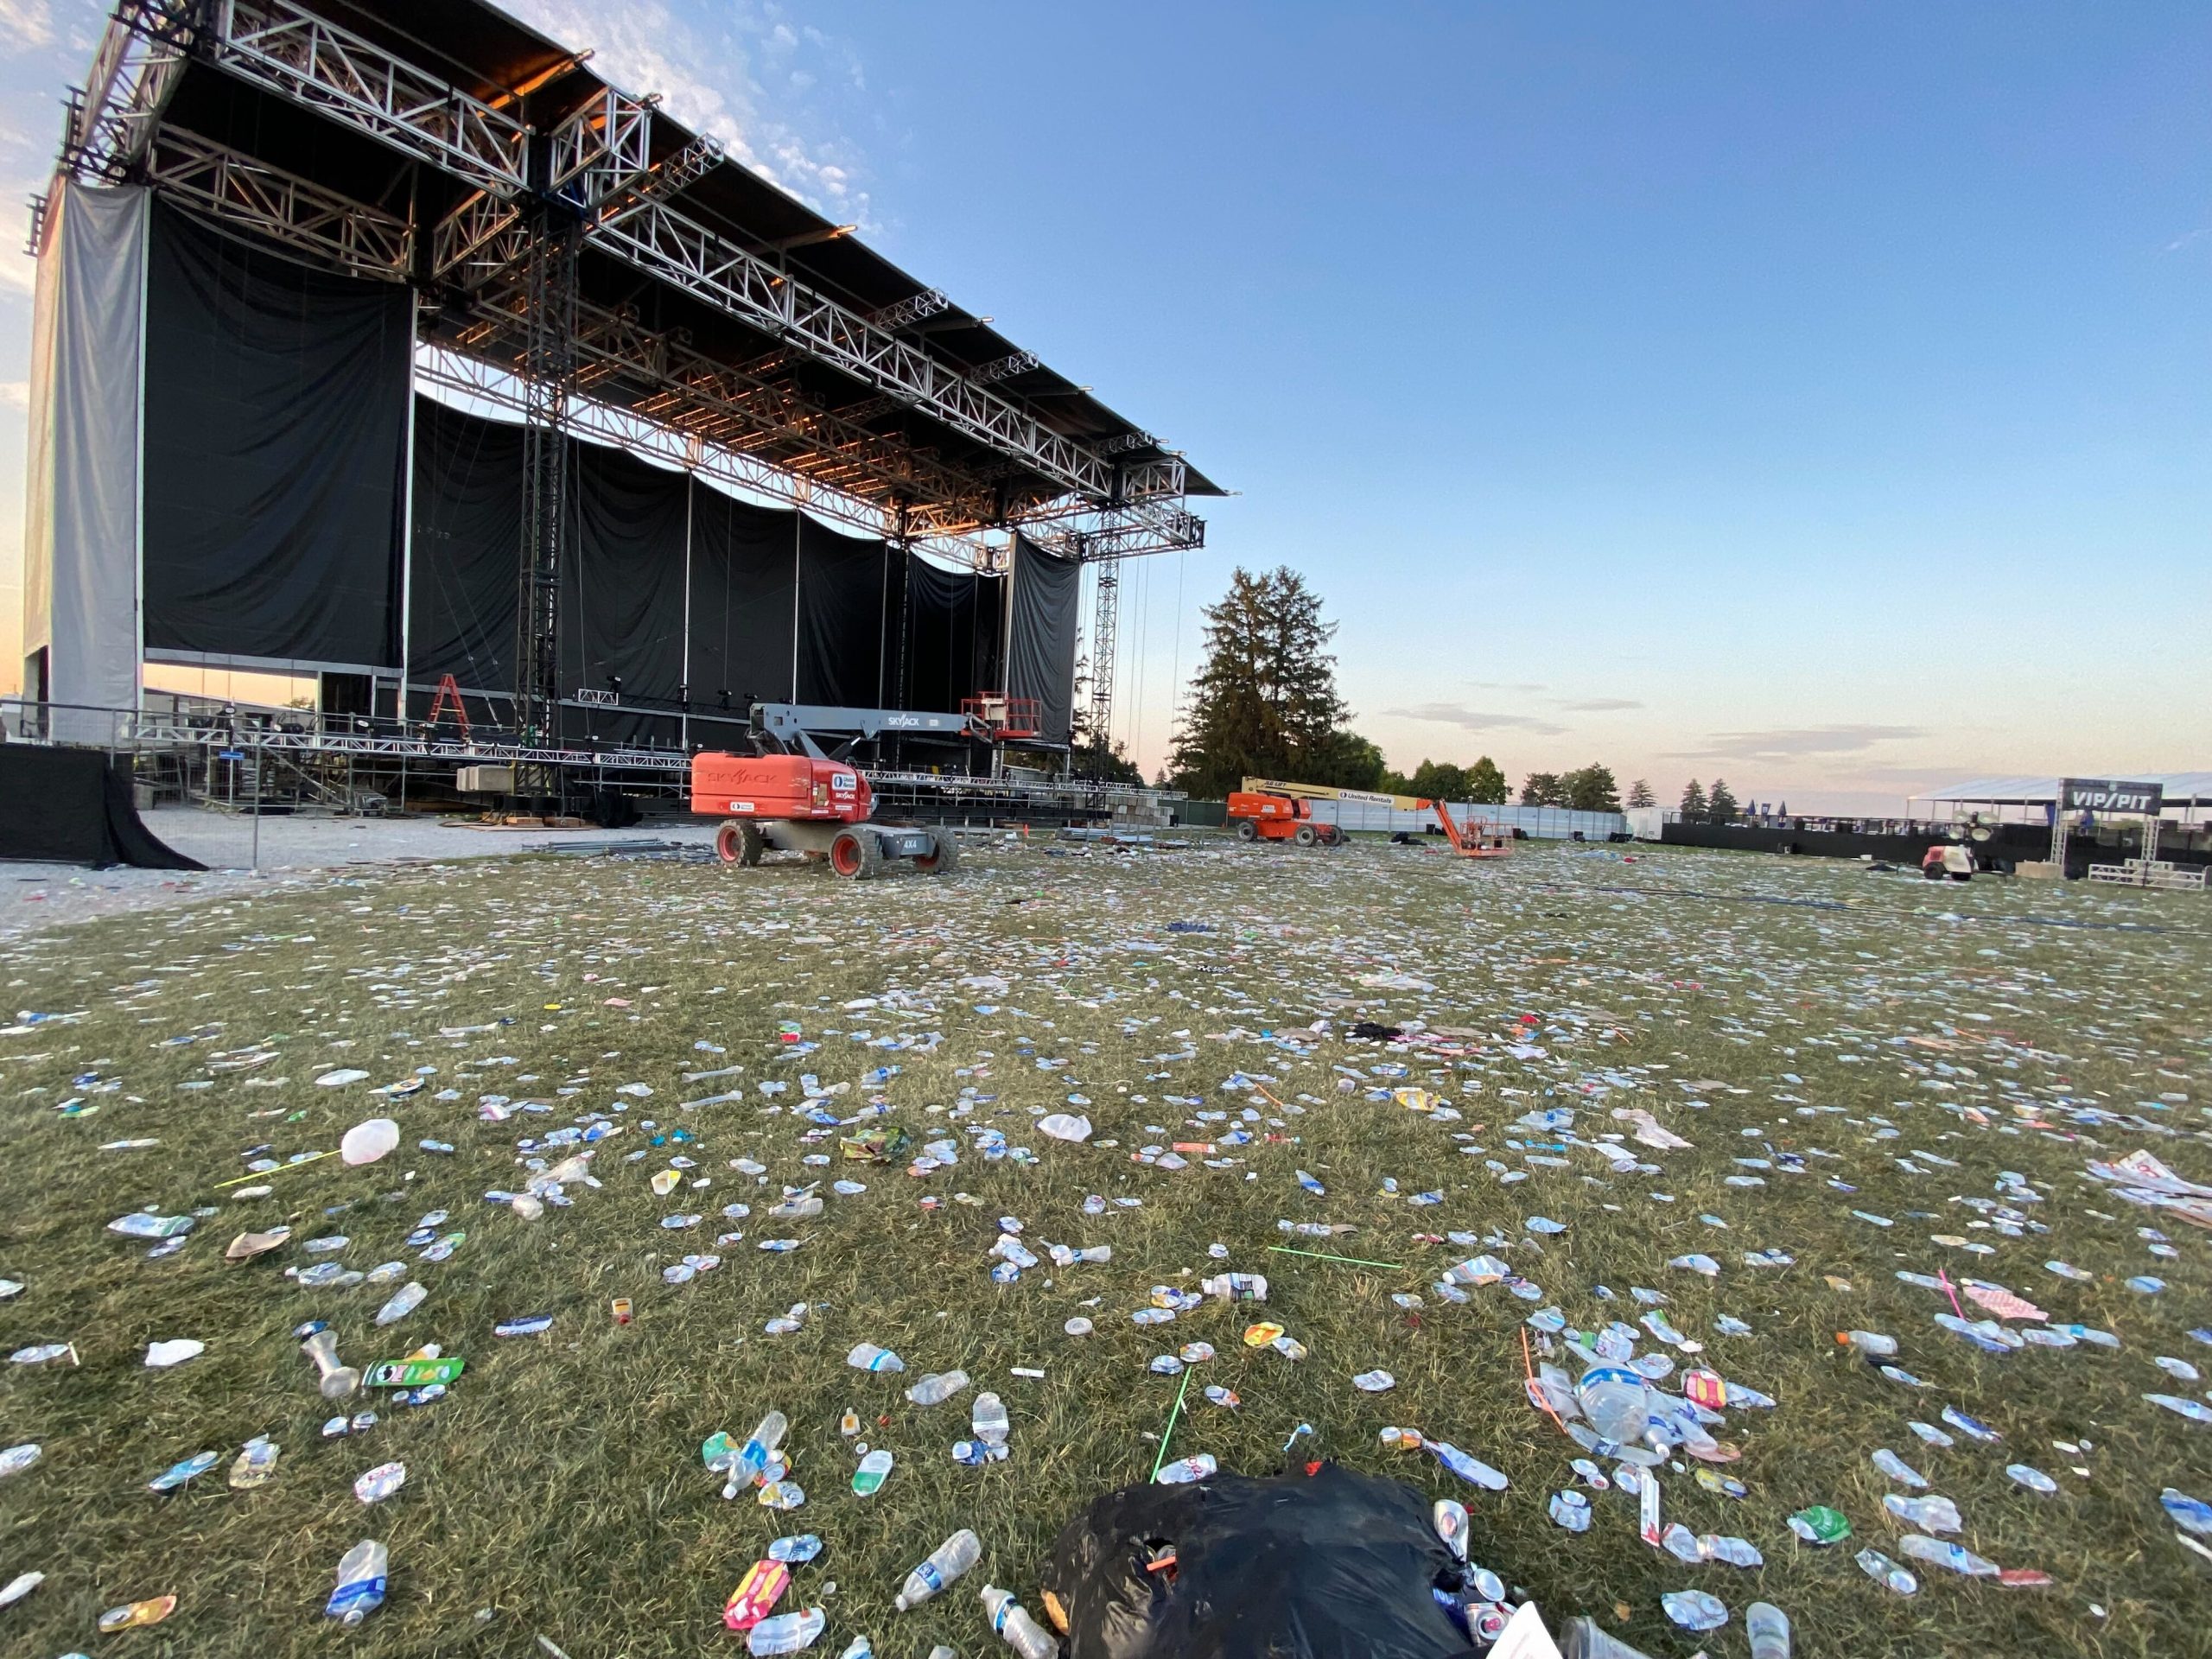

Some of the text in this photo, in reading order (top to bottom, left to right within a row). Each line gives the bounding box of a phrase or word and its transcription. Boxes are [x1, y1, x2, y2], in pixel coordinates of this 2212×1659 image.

[888, 713, 919, 728] SKYJACK
[708, 769, 778, 785] SKYJACK
[1369, 795, 1392, 804] Rentals
[2073, 791, 2152, 810] VIP/PIT
[904, 839, 917, 849] 4X4
